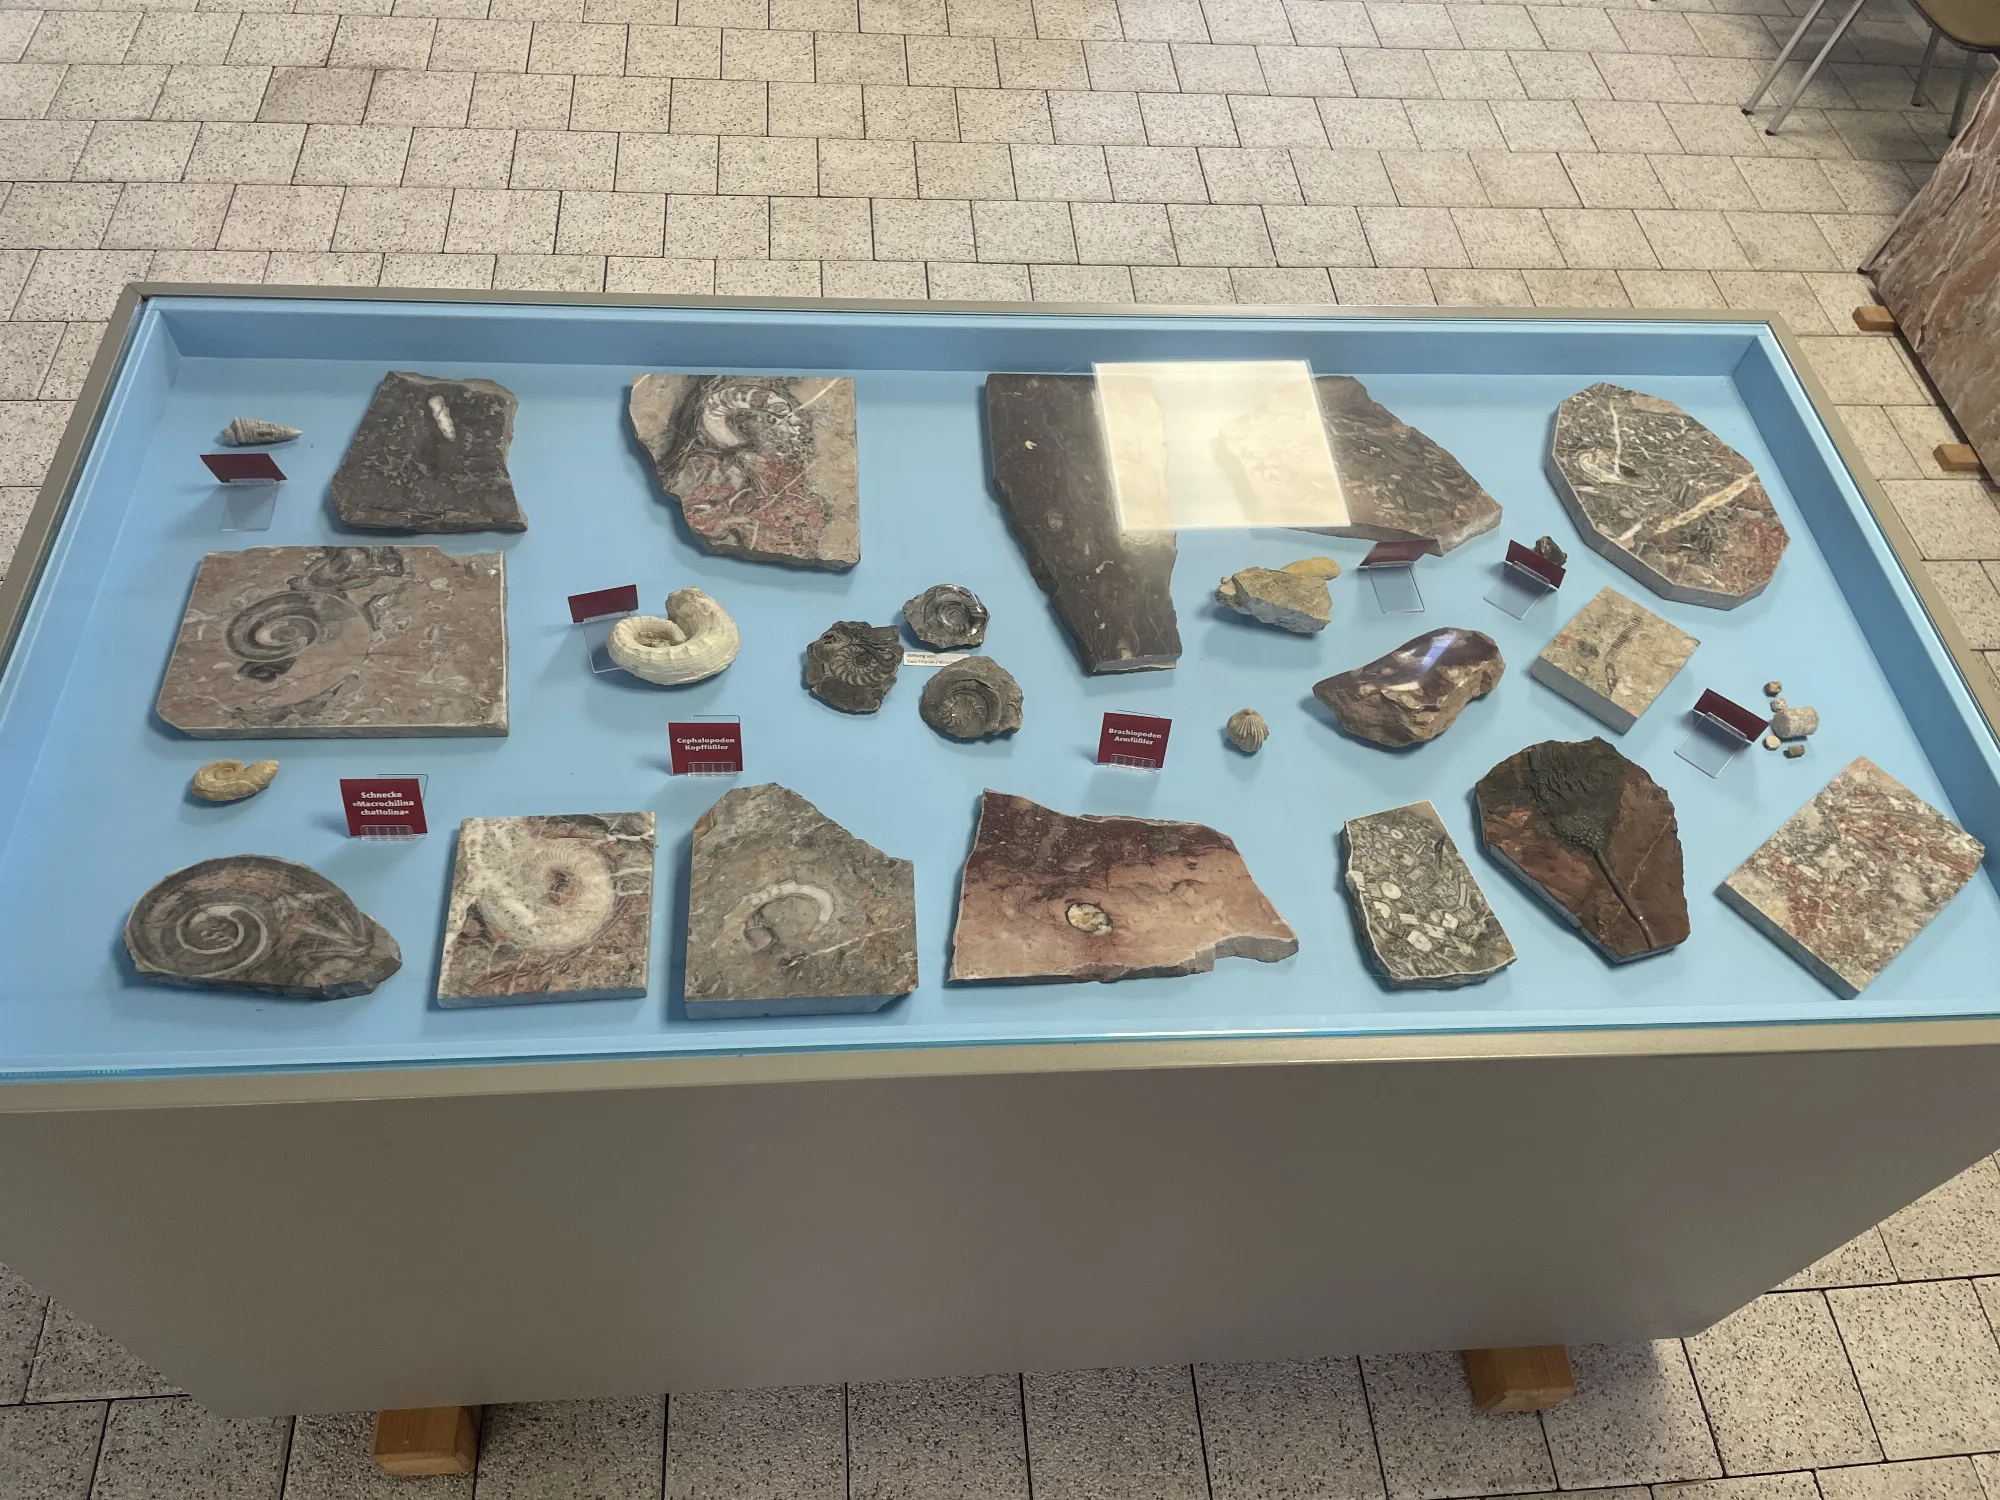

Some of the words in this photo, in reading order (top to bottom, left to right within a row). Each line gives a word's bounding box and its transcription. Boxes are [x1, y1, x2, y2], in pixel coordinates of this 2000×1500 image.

[1108, 728, 1162, 739] Brachiopoden
[676, 737, 735, 745] Cephalopoden
[1114, 736, 1154, 745] Armfüßler
[360, 791, 403, 799] Schnecke
